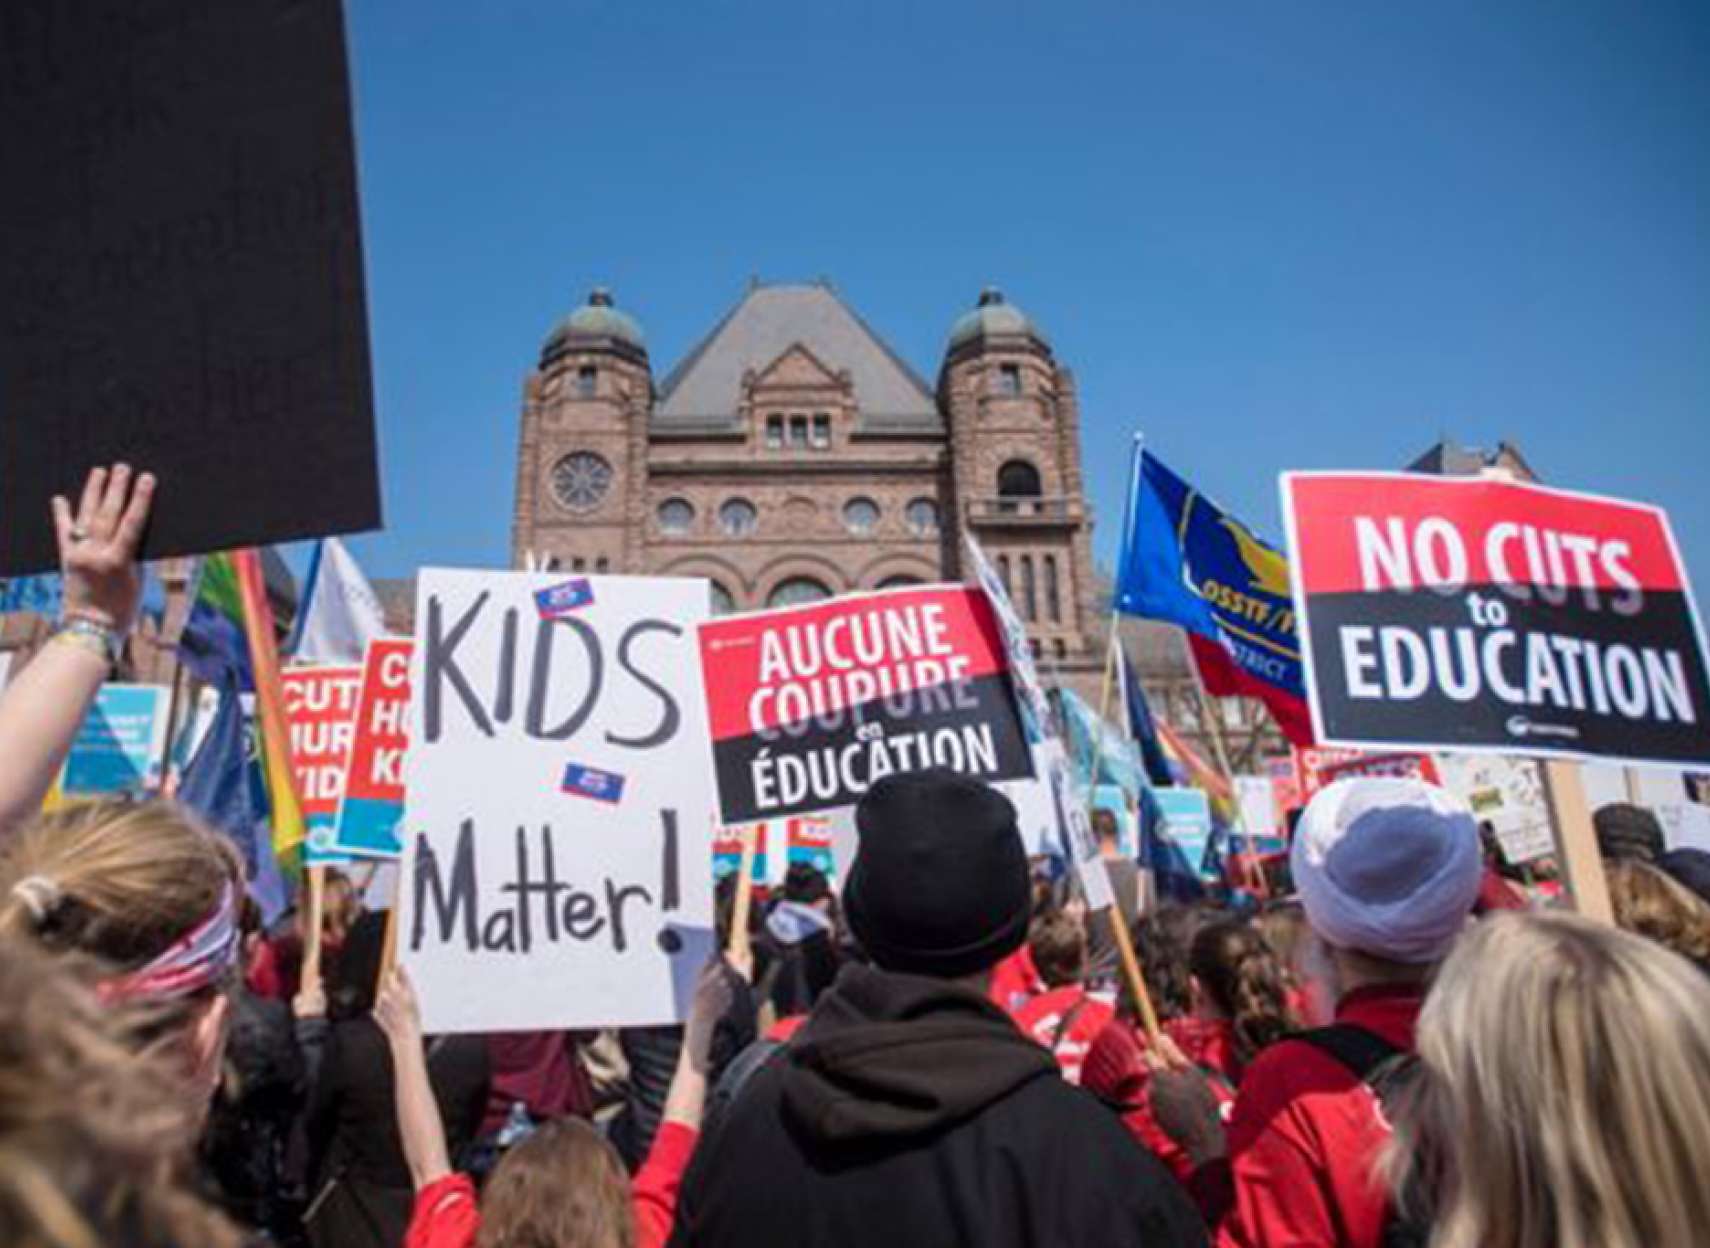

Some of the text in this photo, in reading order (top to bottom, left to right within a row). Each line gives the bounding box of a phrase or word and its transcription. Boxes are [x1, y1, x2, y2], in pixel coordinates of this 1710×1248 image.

[1354, 515, 1644, 616] NO CUTS
[759, 604, 952, 683] AUCUNE
[1466, 592, 1508, 627] to
[423, 590, 683, 749] KIDS
[748, 655, 980, 741] COUPURE
[1339, 625, 1697, 725] EDUCATION
[290, 720, 355, 757] UR
[751, 722, 999, 810] ÉDUCATION
[855, 720, 883, 741] en
[296, 763, 344, 800] ID
[411, 808, 684, 953] Matter!
